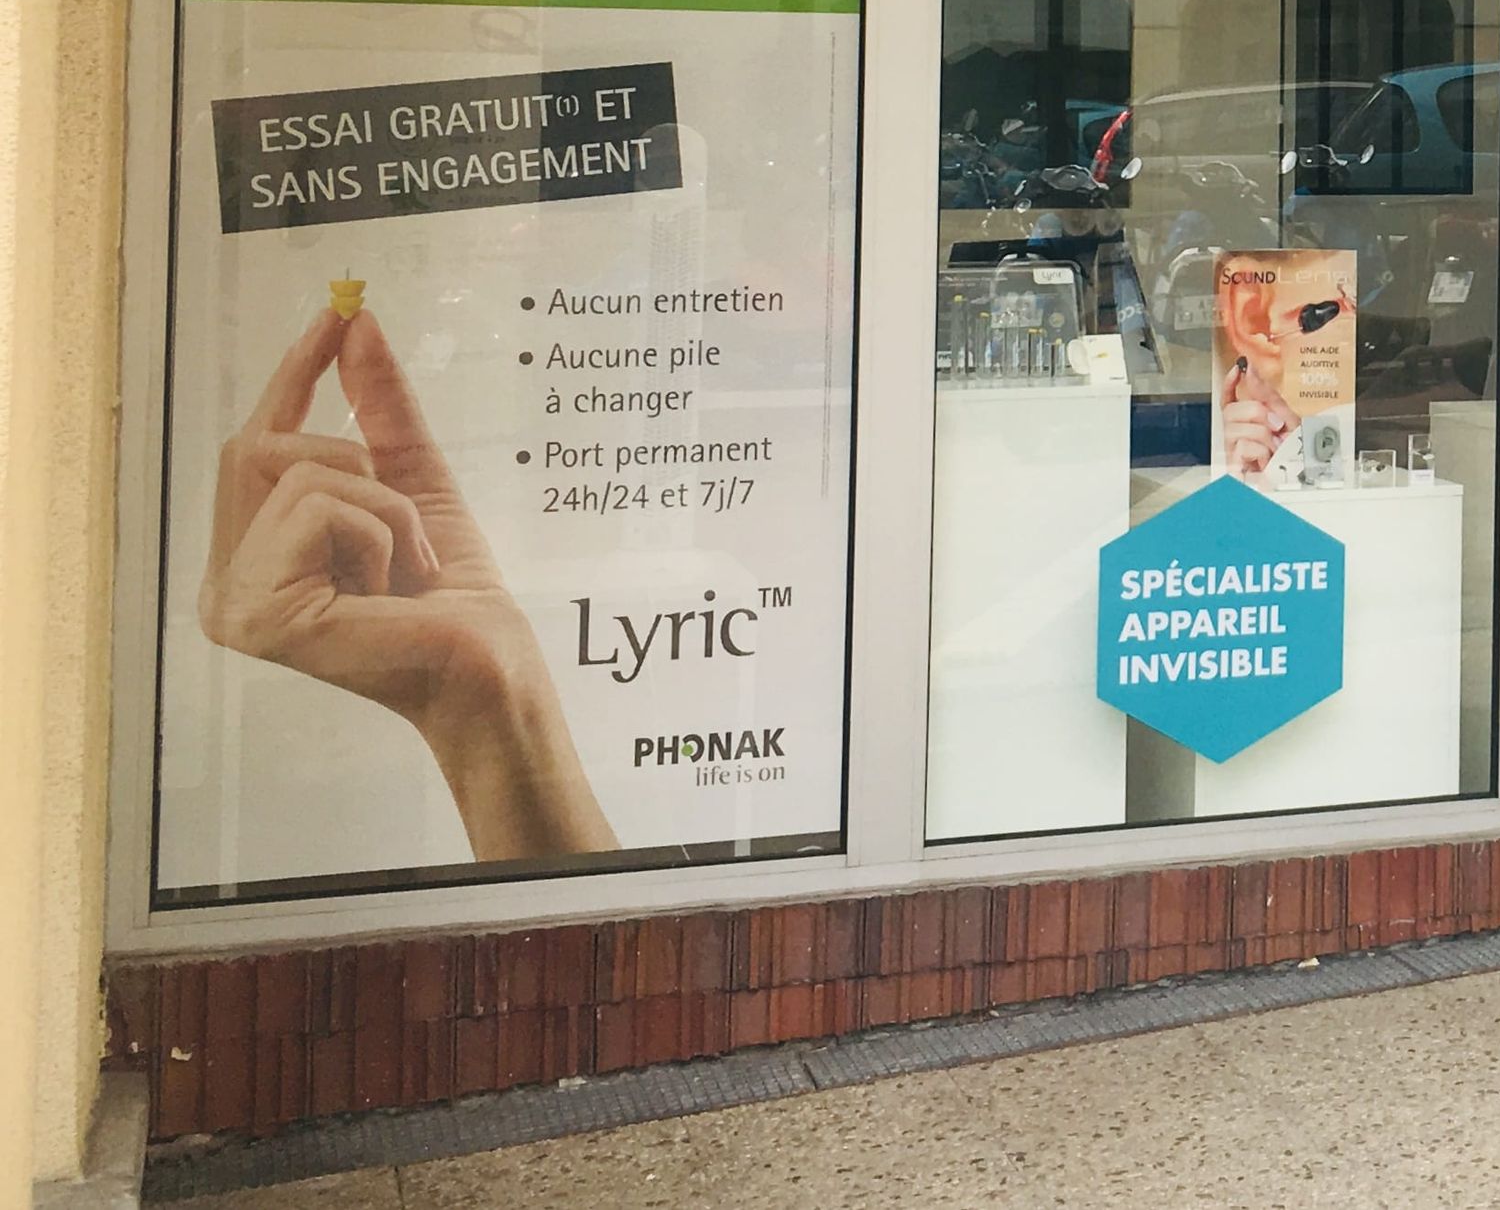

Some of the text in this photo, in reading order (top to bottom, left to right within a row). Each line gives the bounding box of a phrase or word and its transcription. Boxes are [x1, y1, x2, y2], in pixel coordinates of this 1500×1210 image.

[260, 109, 372, 152] ESSAI
[596, 87, 636, 122] ET
[252, 138, 652, 209] SANS ENGAGEMENT
[548, 286, 784, 315] Aucun entretien
[546, 340, 721, 374] Aucune pile
[545, 386, 693, 418] à changer
[545, 437, 772, 473] Port permanent
[542, 476, 755, 515] 24h/24 et 7j/7
[1120, 559, 1328, 600] SPÉCIALISTE
[1118, 605, 1287, 643] APPAREIL
[1118, 646, 1288, 685] INVISIBLE
[634, 728, 785, 767] PHONAK
[696, 765, 785, 787] life is on
